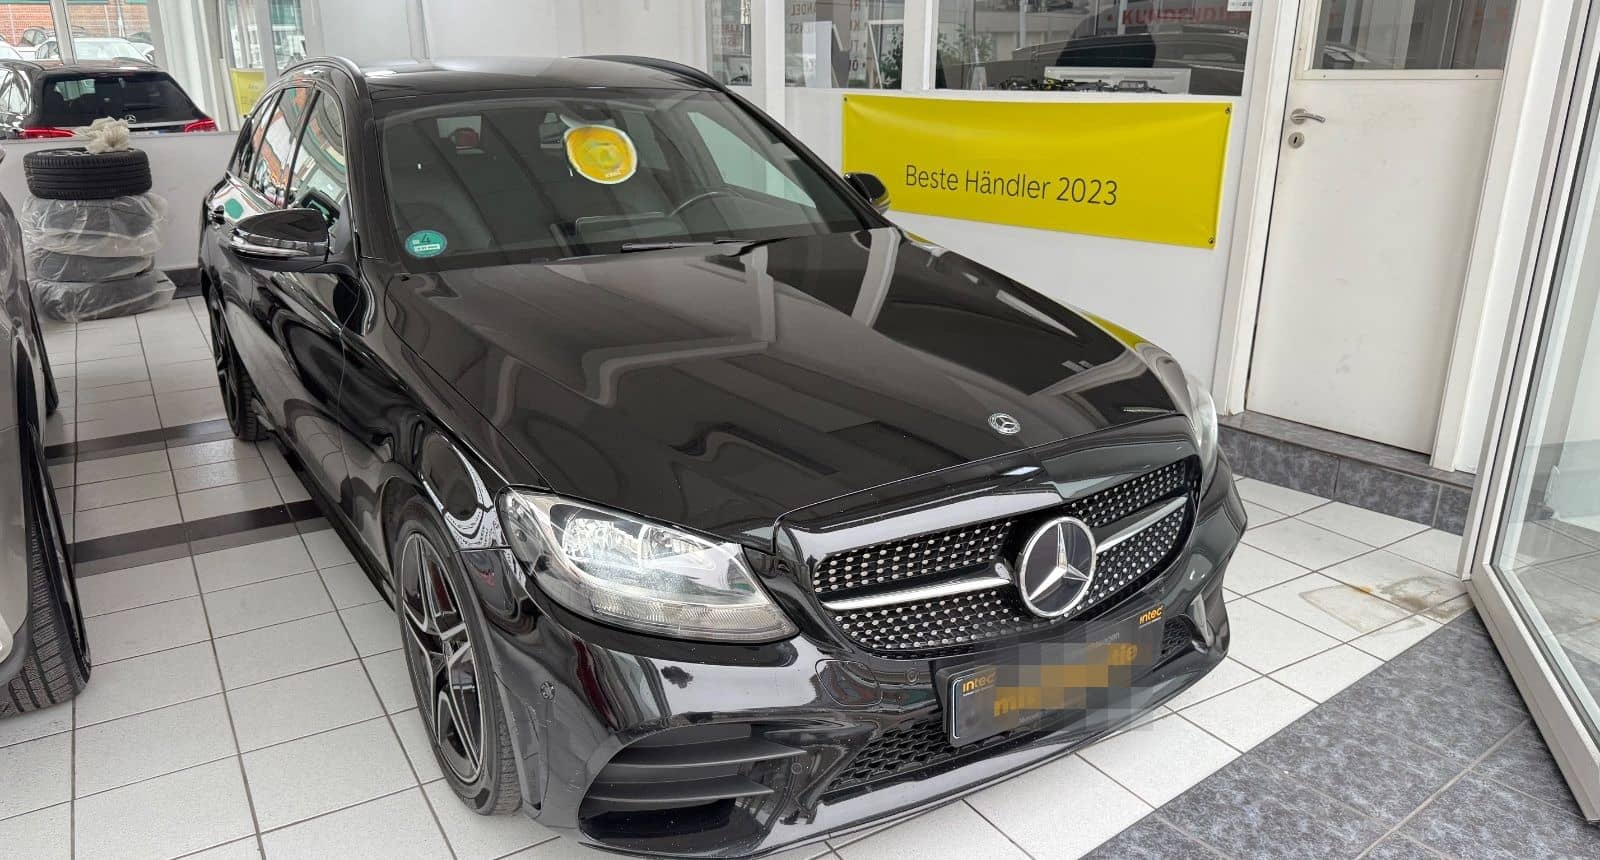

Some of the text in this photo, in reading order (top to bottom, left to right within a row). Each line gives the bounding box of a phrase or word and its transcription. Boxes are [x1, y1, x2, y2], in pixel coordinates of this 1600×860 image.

[905, 164, 1118, 206] Beste Händler 2023
[1139, 605, 1163, 625] intec
